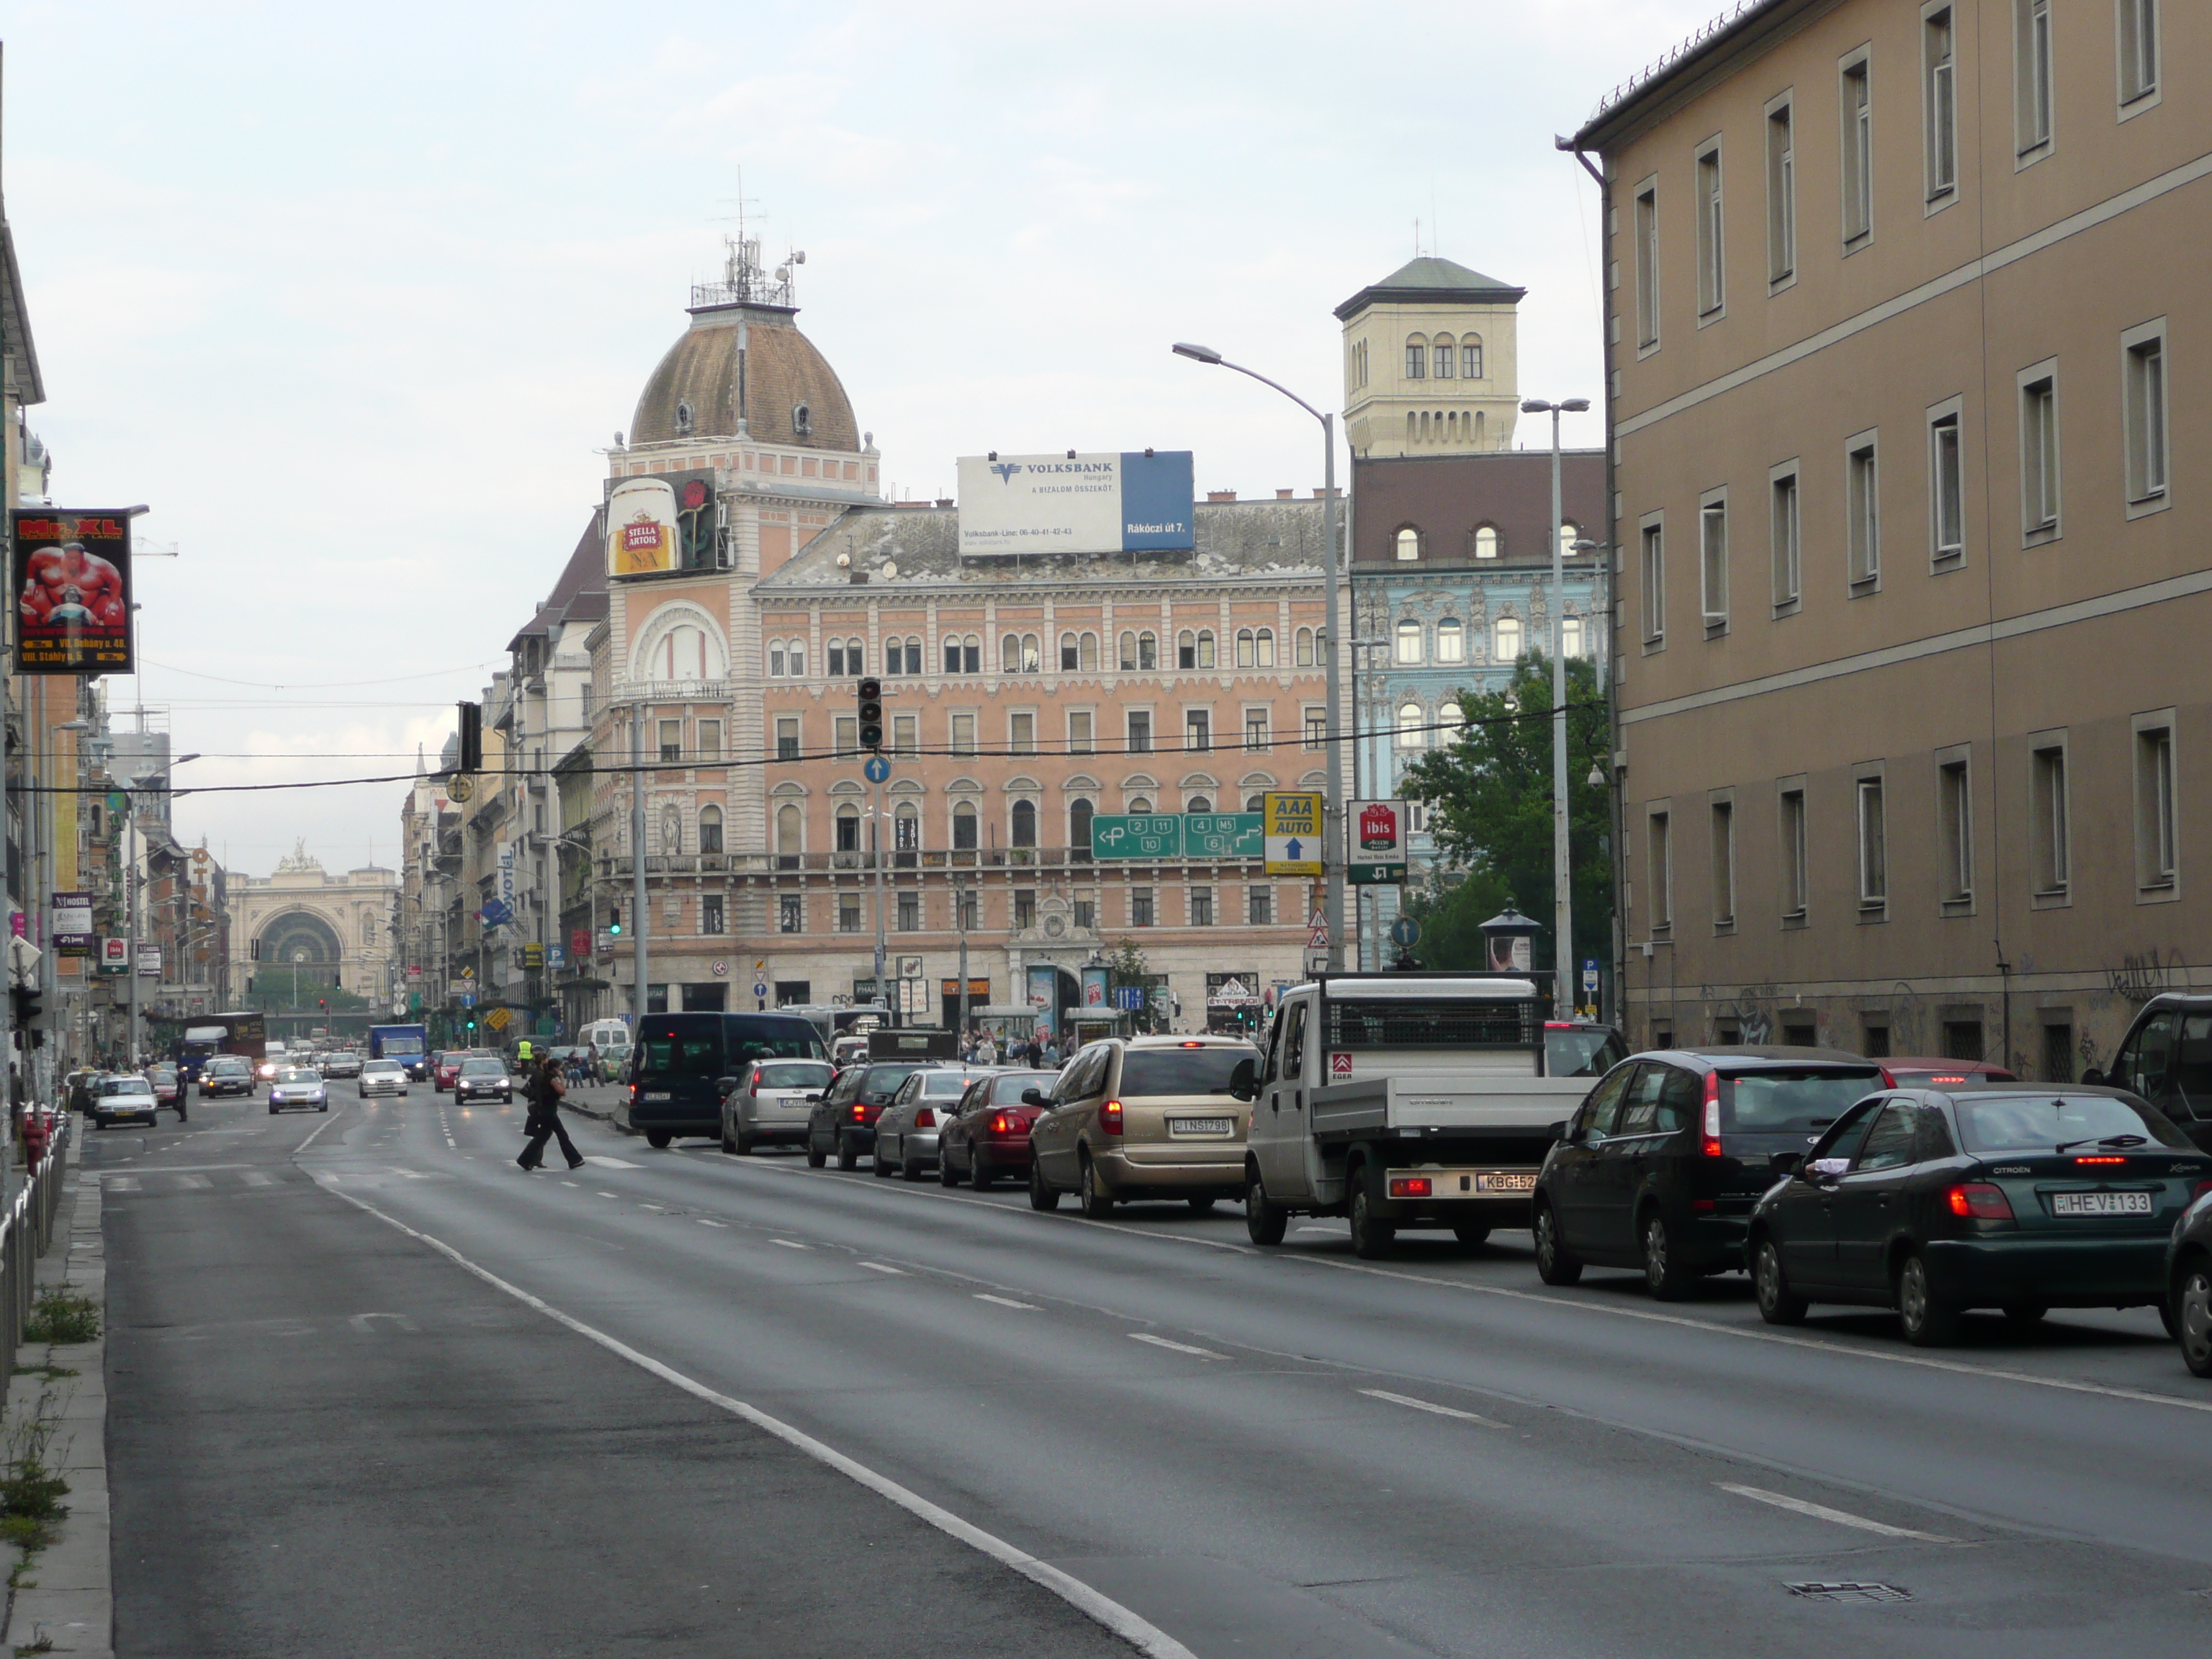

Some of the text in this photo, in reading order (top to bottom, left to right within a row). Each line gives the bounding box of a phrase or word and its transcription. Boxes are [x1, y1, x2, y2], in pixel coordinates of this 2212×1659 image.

[1028, 463, 1113, 473] VOLKSBANK
[74, 519, 122, 535] XL
[629, 527, 655, 537] STELLA
[1128, 523, 1185, 534] Rákóczi út 7.
[629, 536, 657, 546] ARTOIS
[1275, 800, 1312, 814] AAA
[1275, 822, 1313, 833] AUTO
[1367, 822, 1390, 833] ibis
[1210, 839, 1218, 848] 6
[502, 850, 513, 916] OVOTEL
[552, 950, 561, 963] P
[1587, 961, 1593, 969] P
[2070, 1195, 2149, 1211] HEV-133
